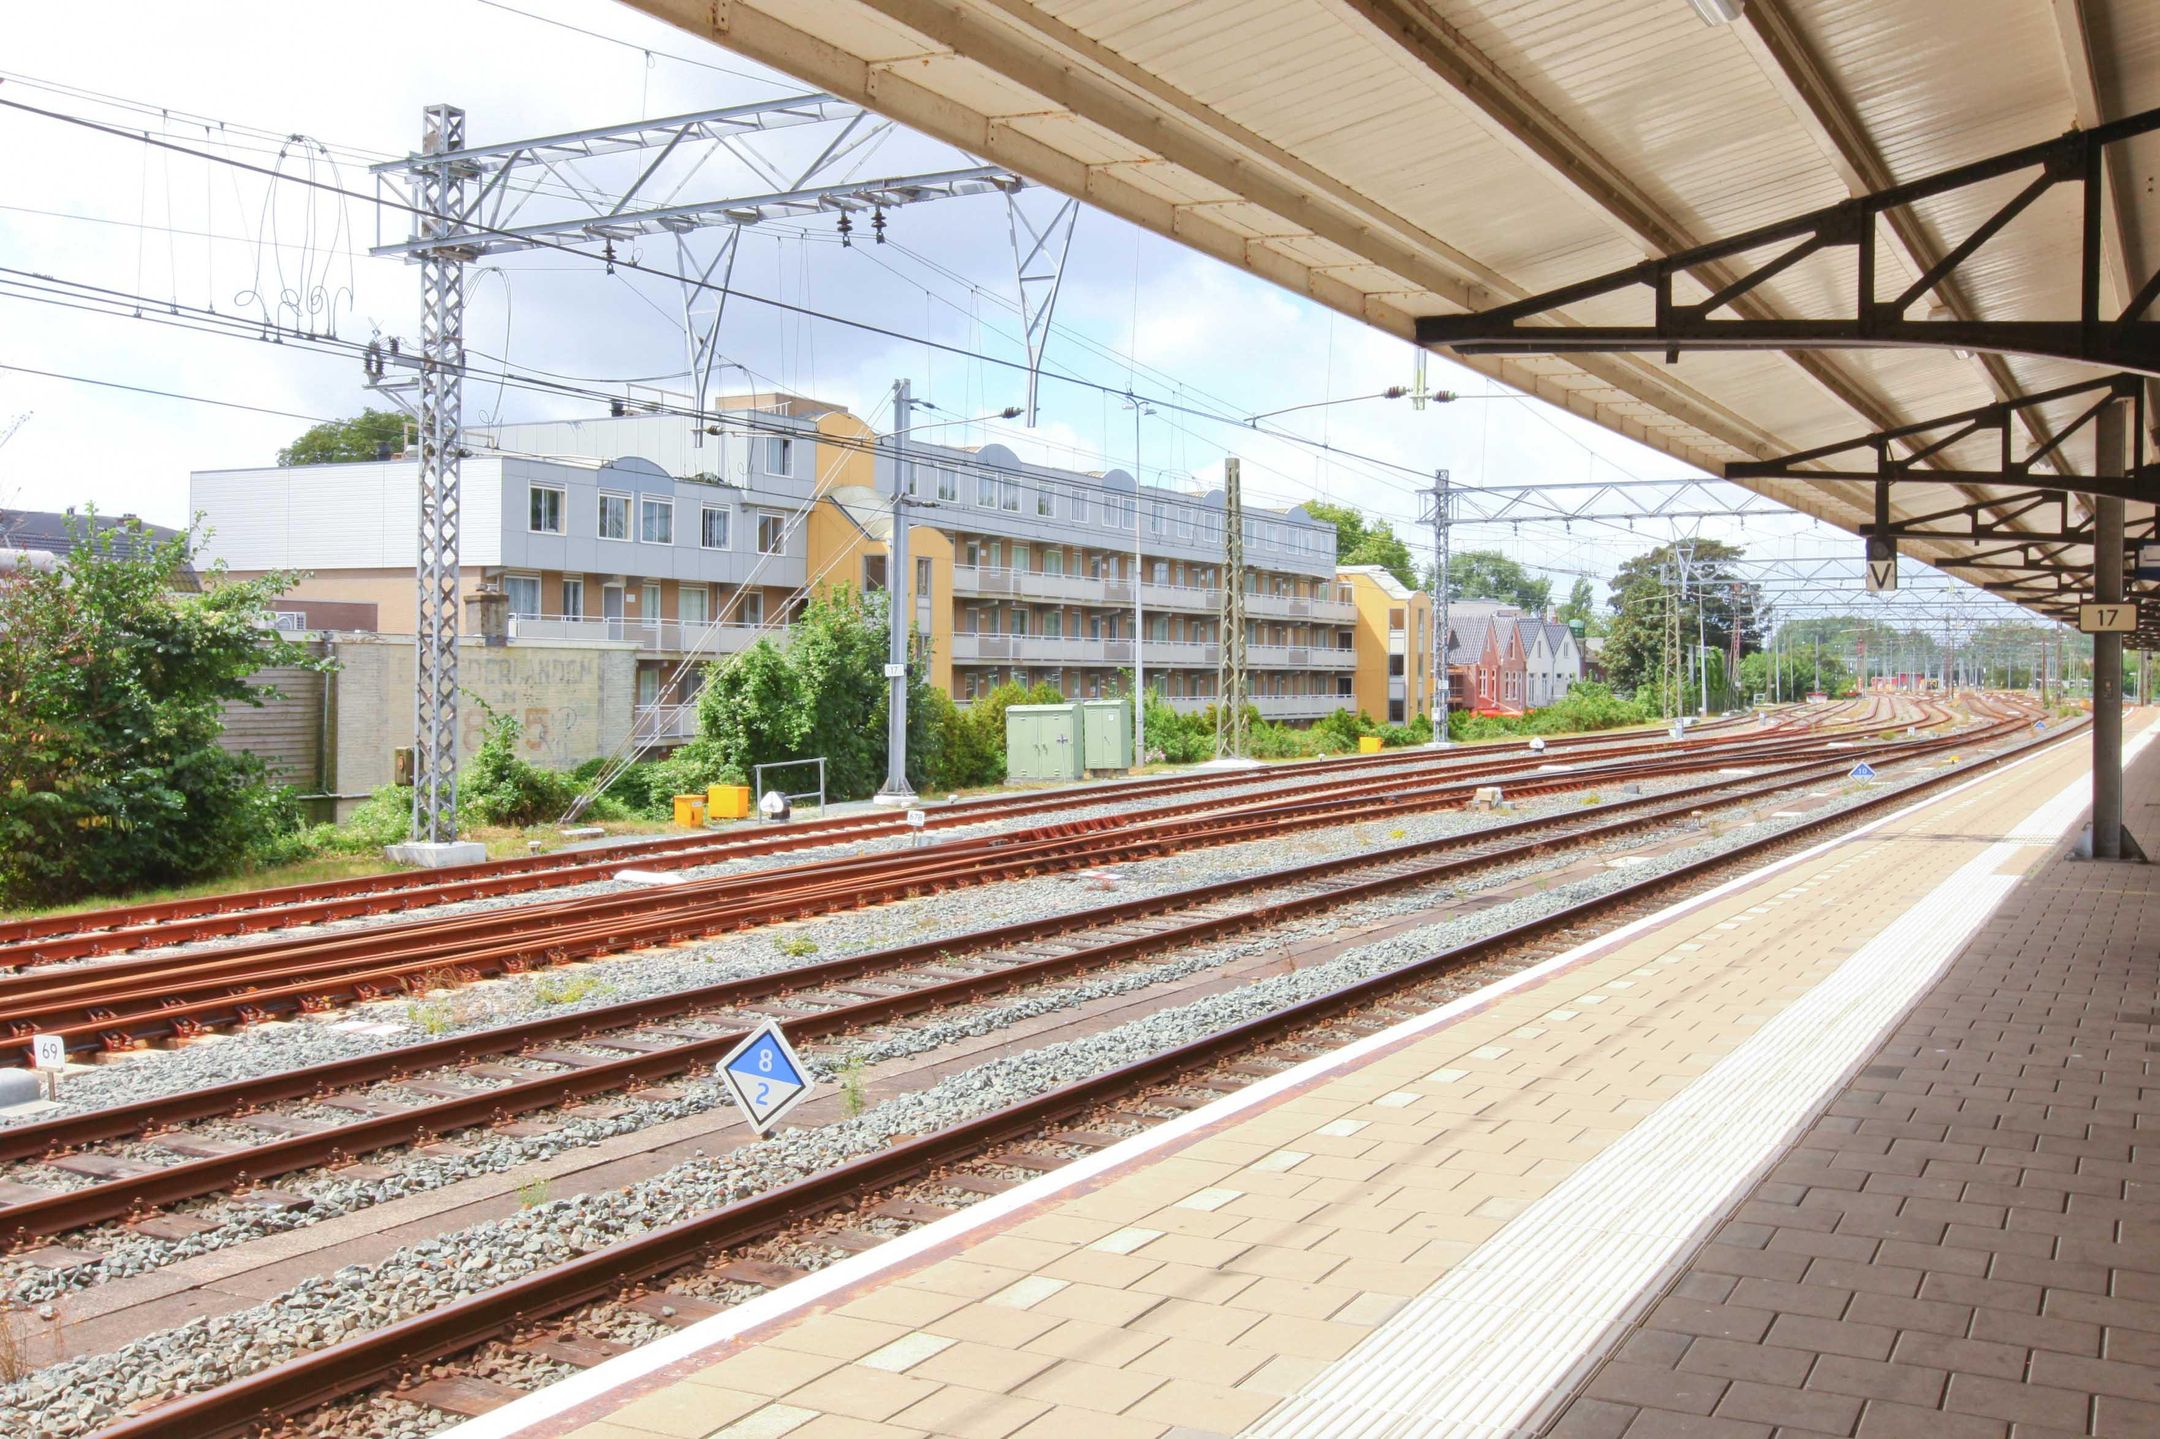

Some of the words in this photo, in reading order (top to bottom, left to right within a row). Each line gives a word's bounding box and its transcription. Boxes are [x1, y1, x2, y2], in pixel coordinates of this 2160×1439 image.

[1869, 563, 1892, 589] V
[2098, 609, 2119, 627] 17
[1858, 767, 1868, 775] 10
[42, 1042, 58, 1060] 69
[758, 1048, 773, 1073] 8
[755, 1082, 770, 1106] 2
